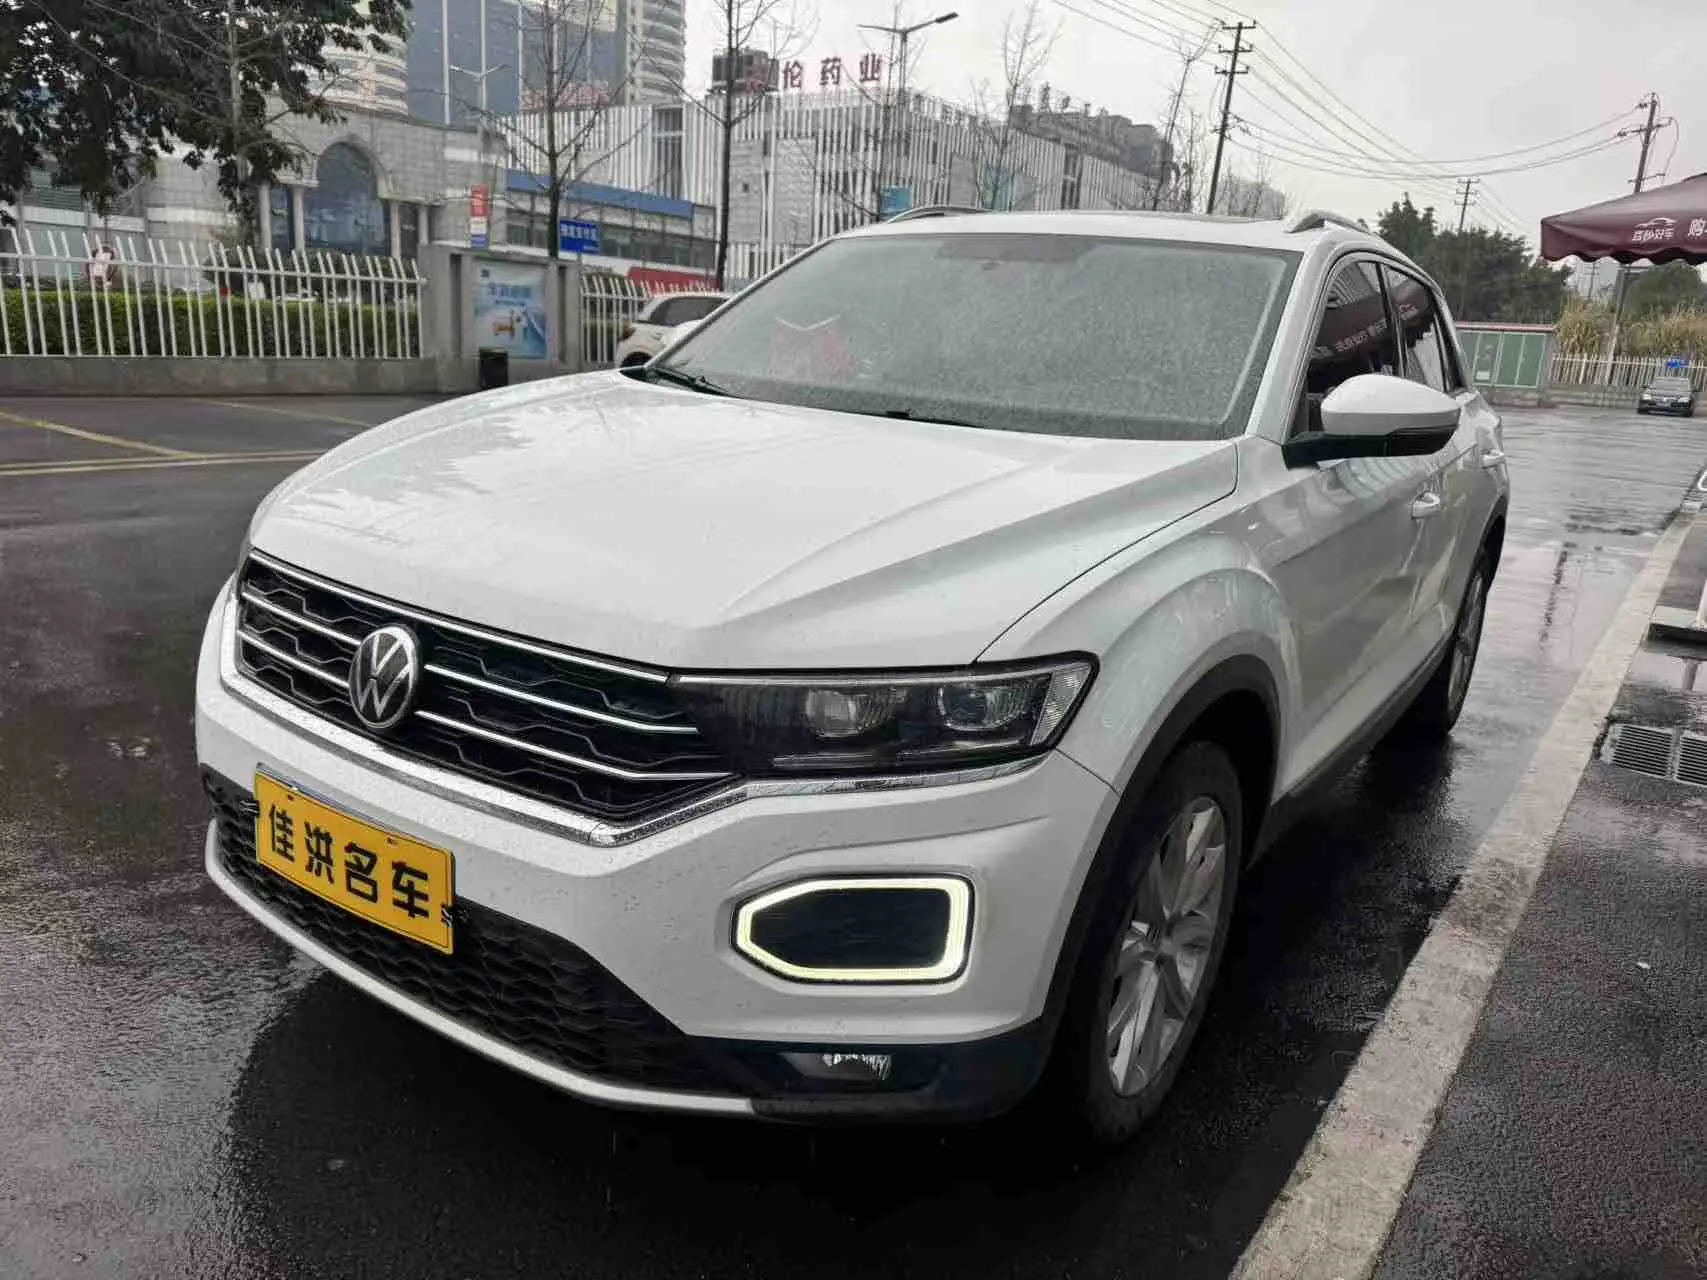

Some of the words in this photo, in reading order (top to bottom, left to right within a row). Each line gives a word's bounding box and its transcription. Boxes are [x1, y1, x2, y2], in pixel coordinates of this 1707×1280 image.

[1688, 218, 1707, 237] 购
[269, 803, 430, 919] 佳洪名车
